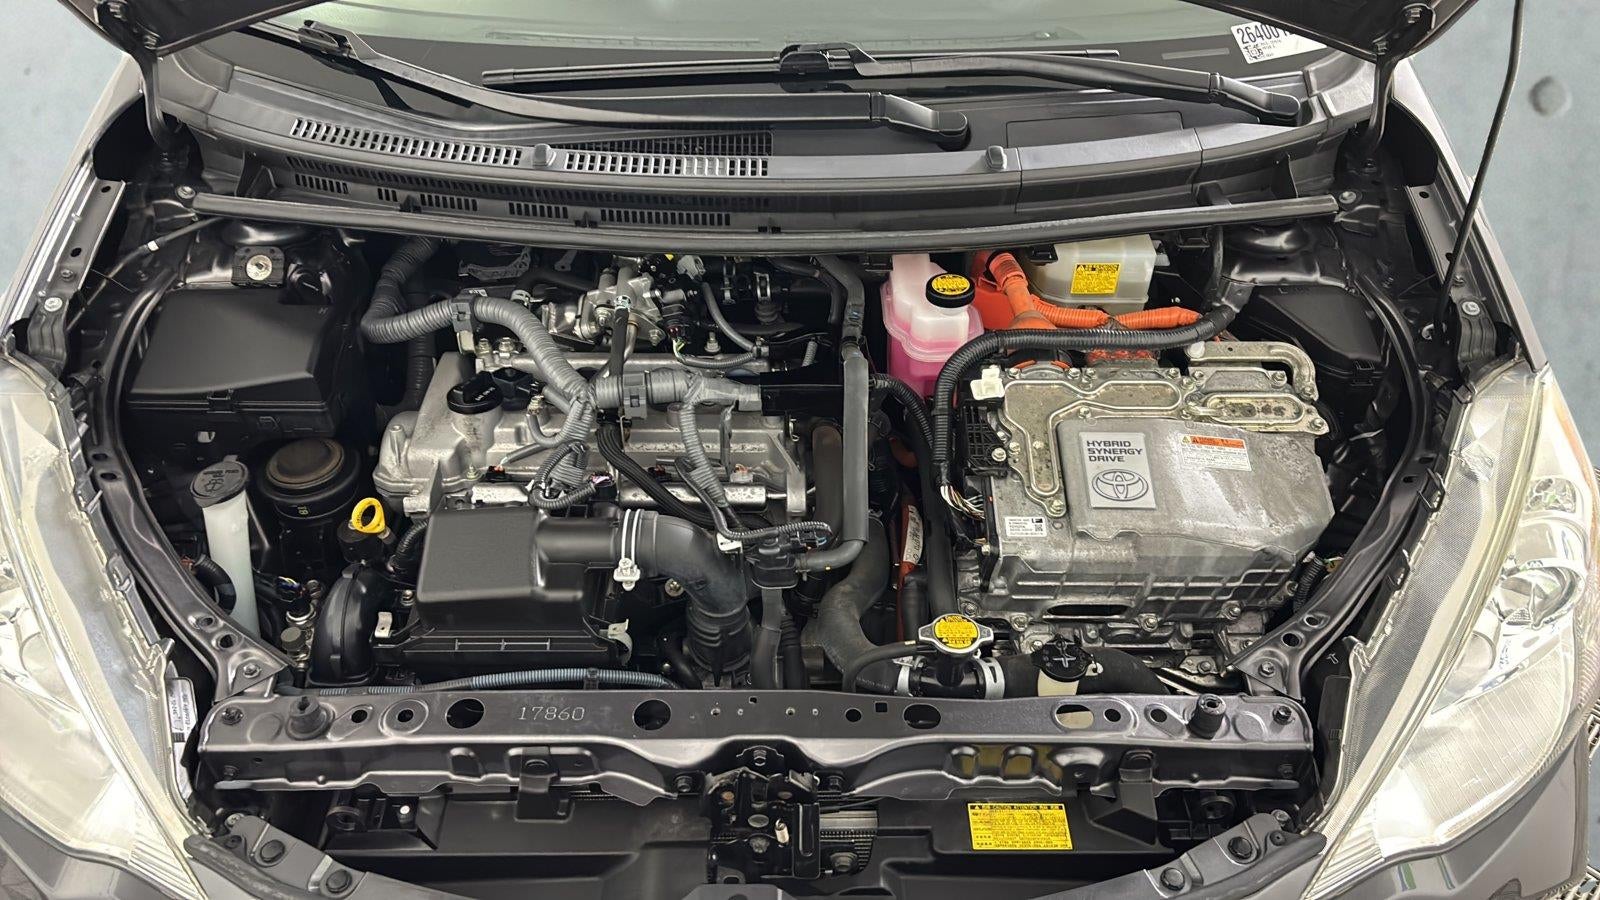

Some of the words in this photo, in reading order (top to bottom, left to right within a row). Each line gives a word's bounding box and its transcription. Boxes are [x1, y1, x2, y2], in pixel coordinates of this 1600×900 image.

[1086, 440, 1132, 448] HYBRID
[1088, 455, 1126, 463] DRIVE
[518, 706, 585, 721] 17860
